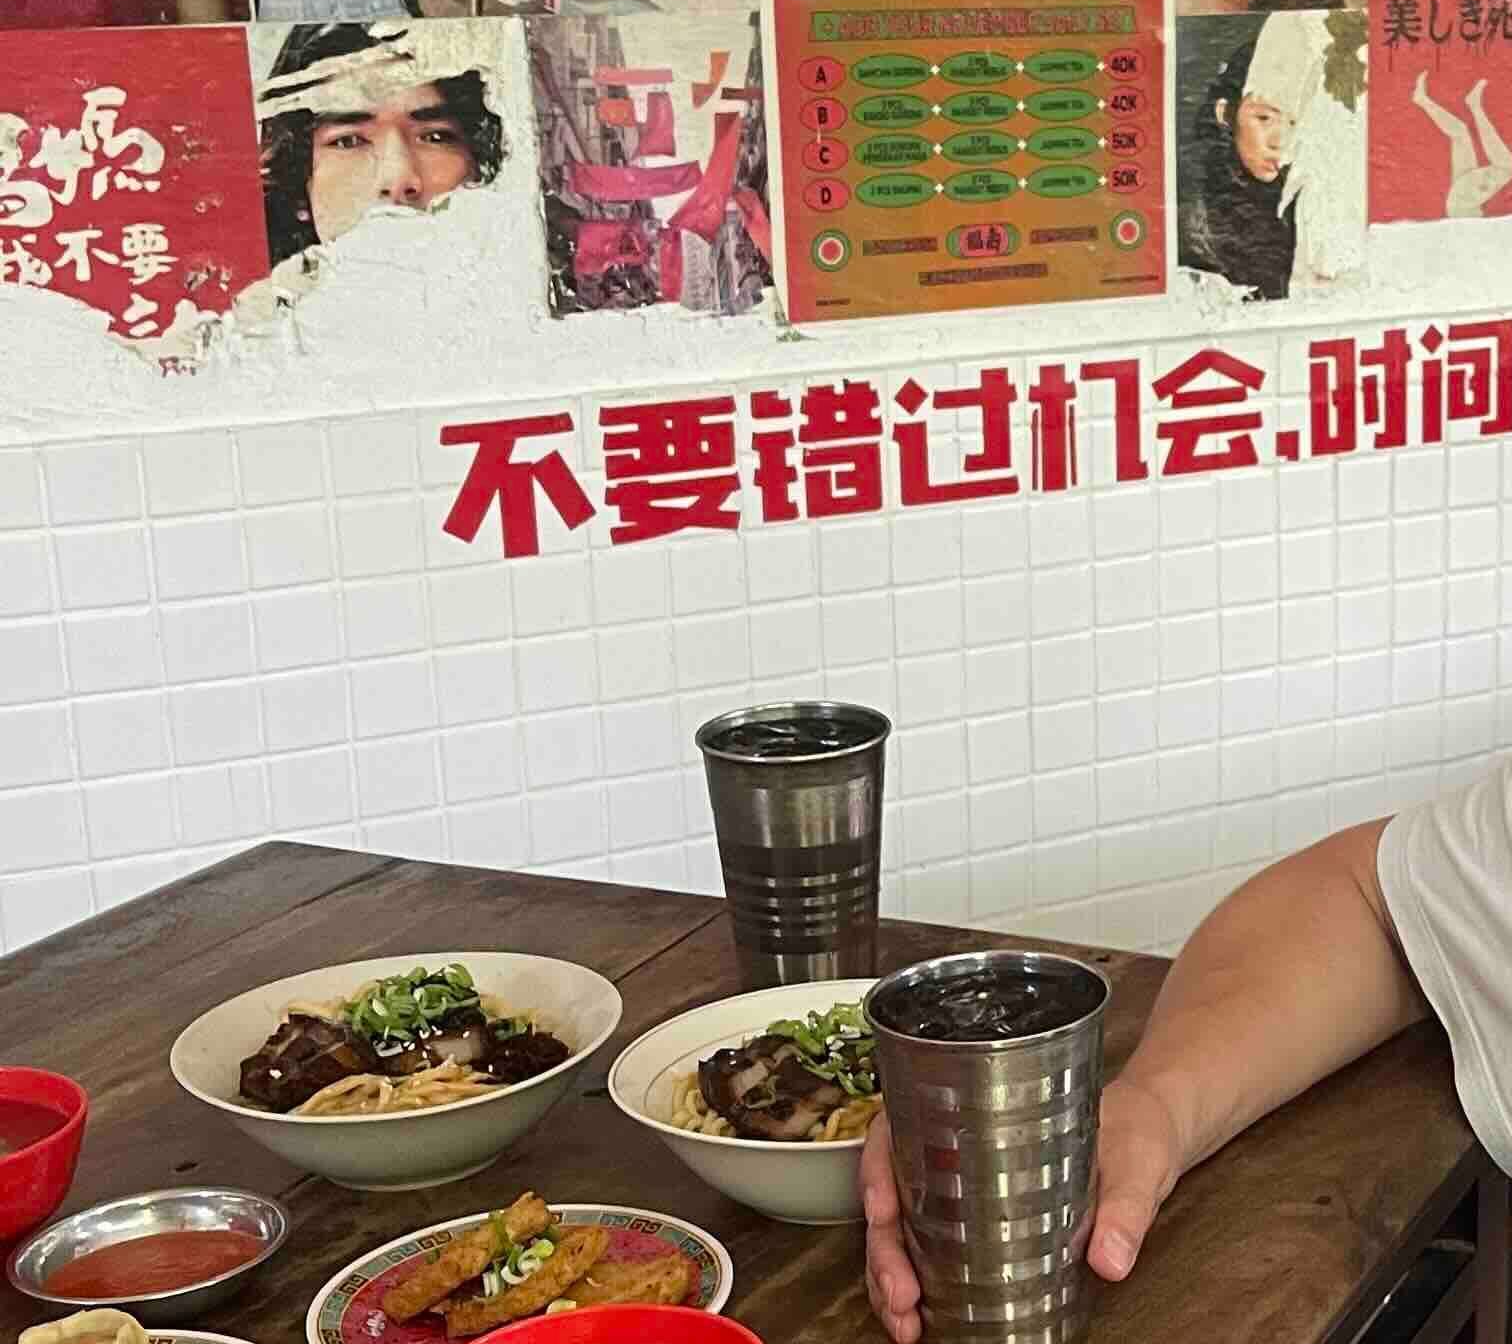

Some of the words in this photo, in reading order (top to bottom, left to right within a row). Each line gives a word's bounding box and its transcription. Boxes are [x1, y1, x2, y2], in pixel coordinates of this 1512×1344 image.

[815, 65, 827, 85] A
[816, 105, 829, 126] B
[818, 146, 830, 165] C
[820, 186, 832, 206] D
